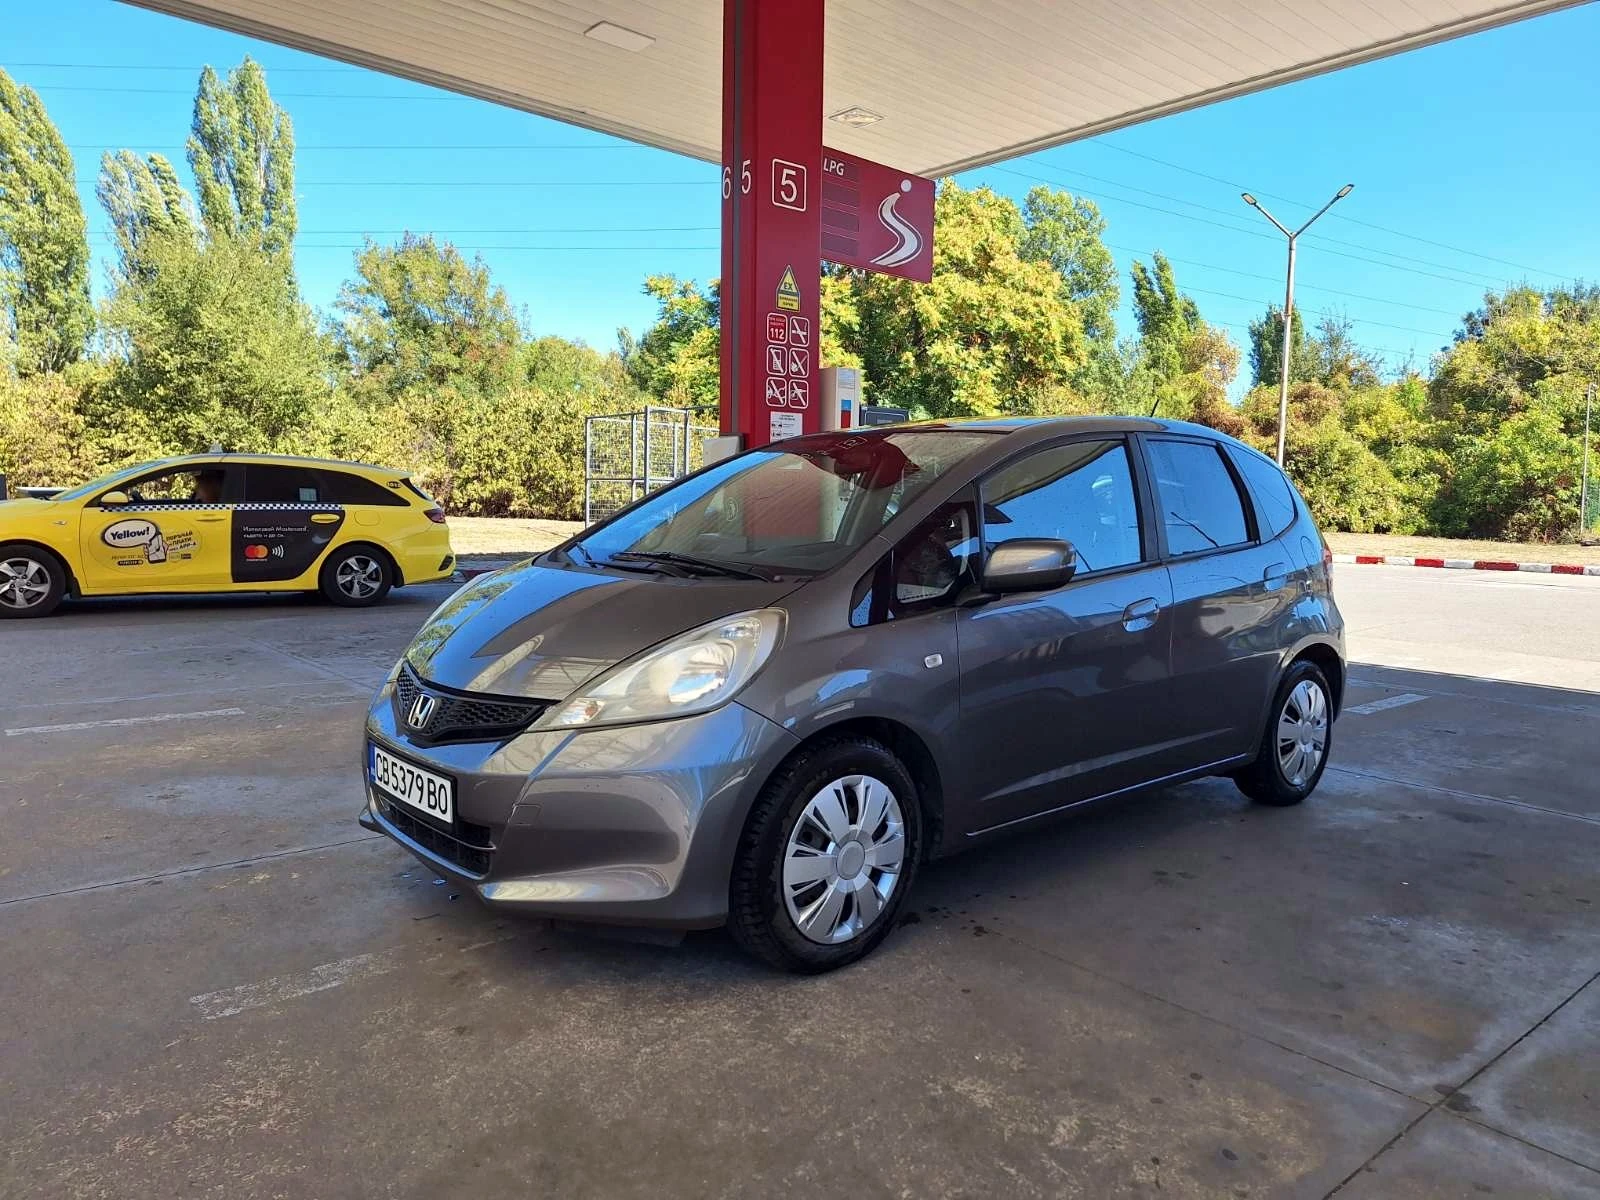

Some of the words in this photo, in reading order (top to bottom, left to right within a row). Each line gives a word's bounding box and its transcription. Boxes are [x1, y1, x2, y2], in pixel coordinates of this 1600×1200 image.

[741, 159, 751, 194] 5
[823, 158, 845, 176] LPG
[722, 166, 731, 199] 6
[780, 168, 797, 203] 5
[770, 327, 785, 340] 112
[111, 527, 150, 540] Yellow!
